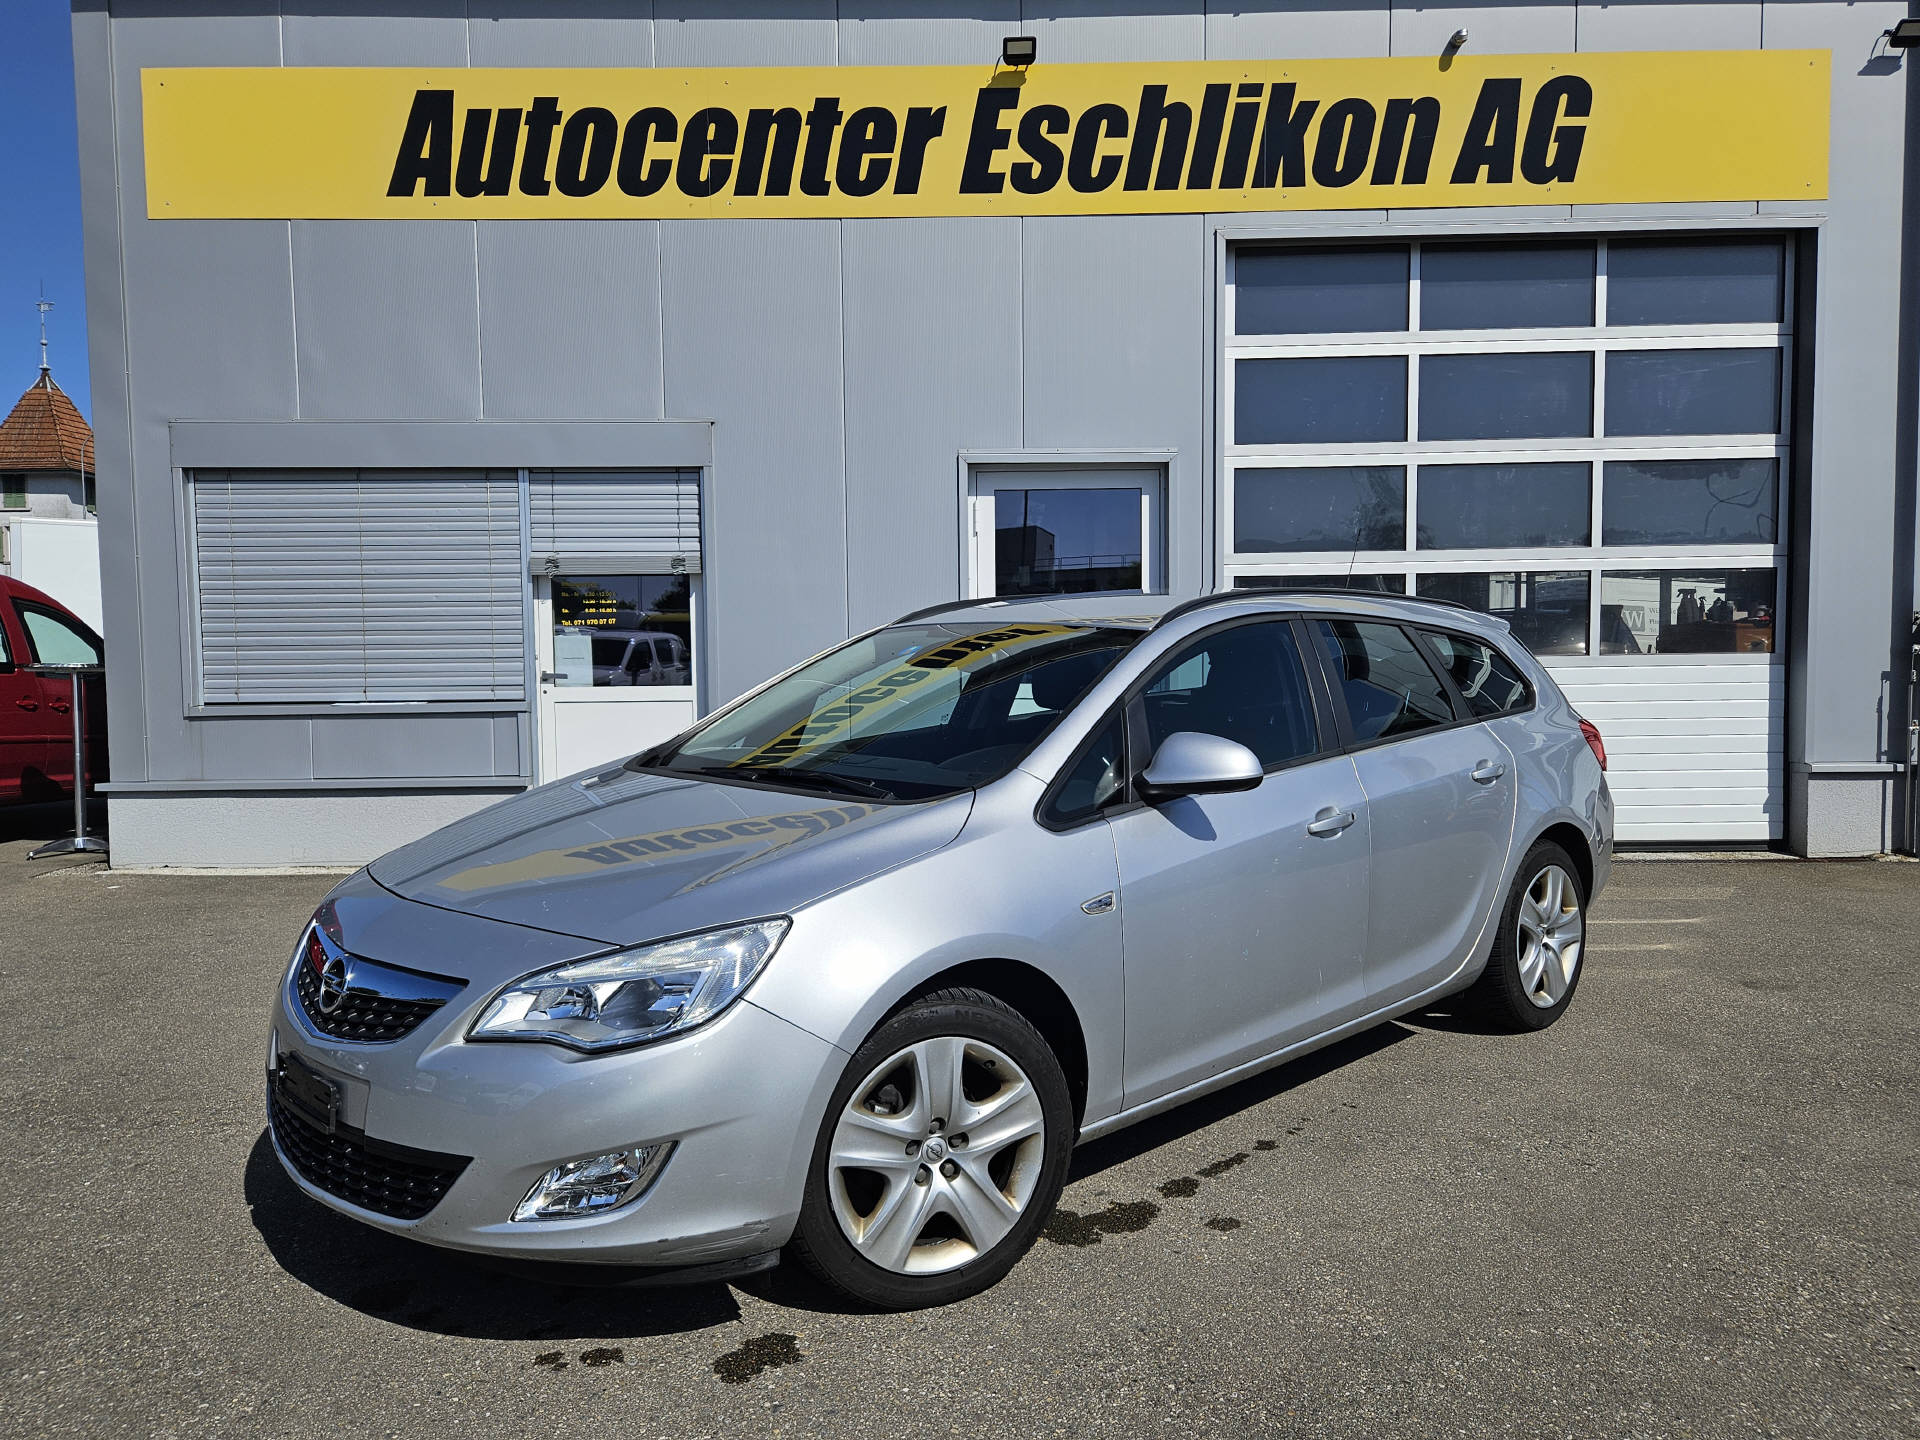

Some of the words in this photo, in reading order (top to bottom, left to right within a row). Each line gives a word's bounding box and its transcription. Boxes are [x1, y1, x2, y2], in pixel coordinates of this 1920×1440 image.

[387, 90, 947, 197] Autocenter
[959, 83, 1440, 193] Eschlikon
[1450, 76, 1592, 188] AG
